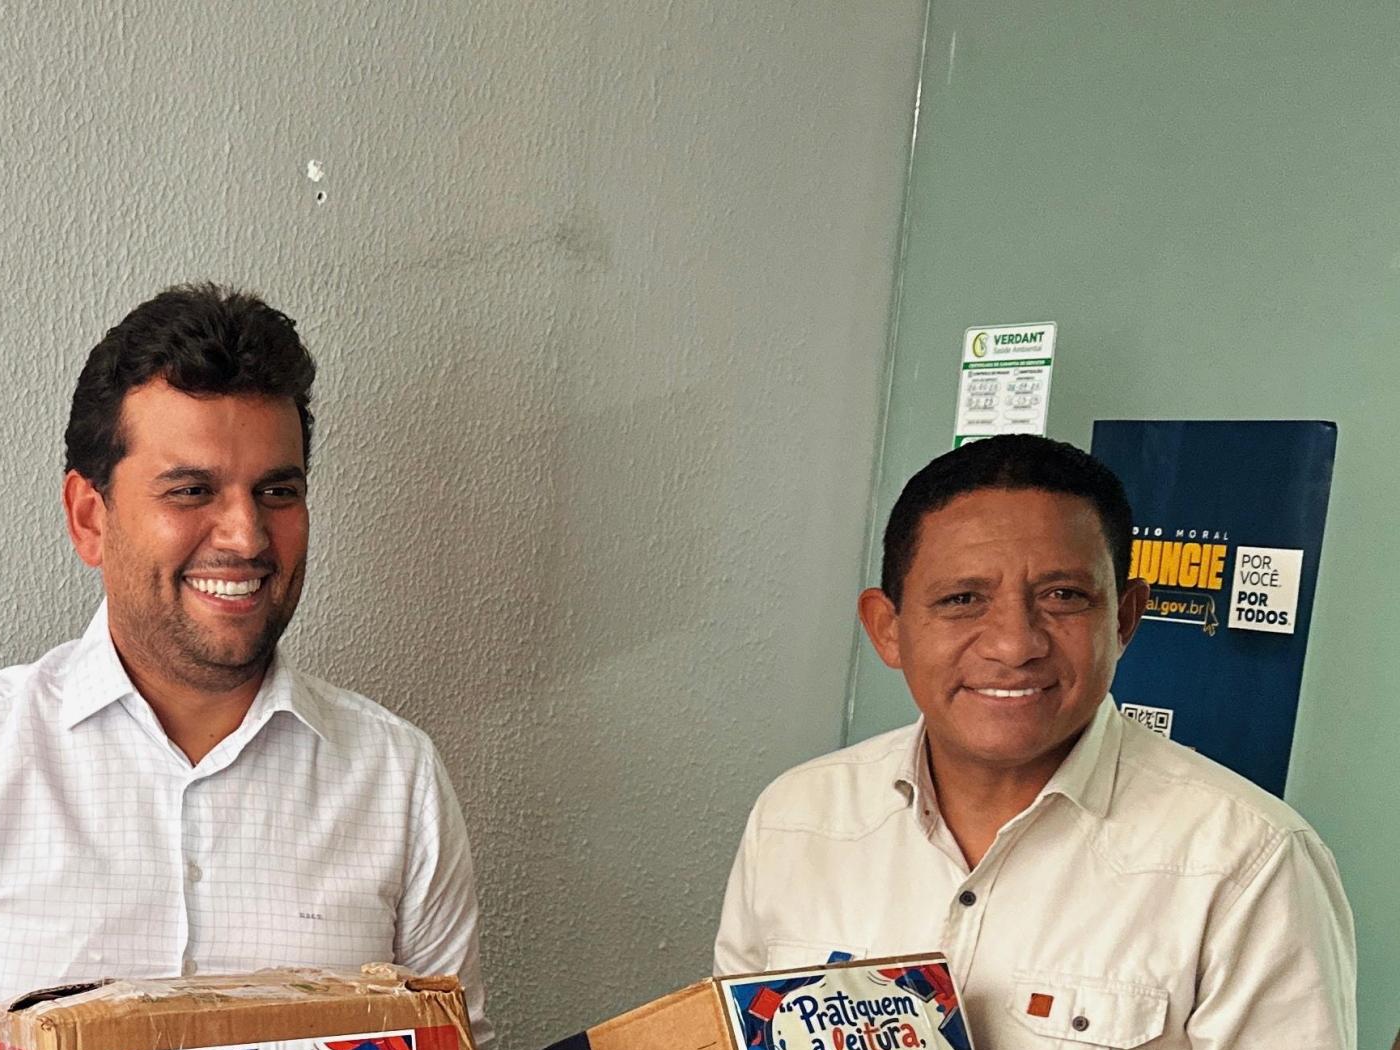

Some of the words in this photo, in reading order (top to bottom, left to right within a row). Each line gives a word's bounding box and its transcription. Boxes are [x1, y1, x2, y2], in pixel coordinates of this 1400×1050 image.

[994, 332, 1045, 345] VERDANT
[1175, 528, 1230, 541] MORAL
[1241, 554, 1272, 570] POR
[1145, 597, 1206, 615] al.gov.br
[1237, 591, 1268, 606] POR
